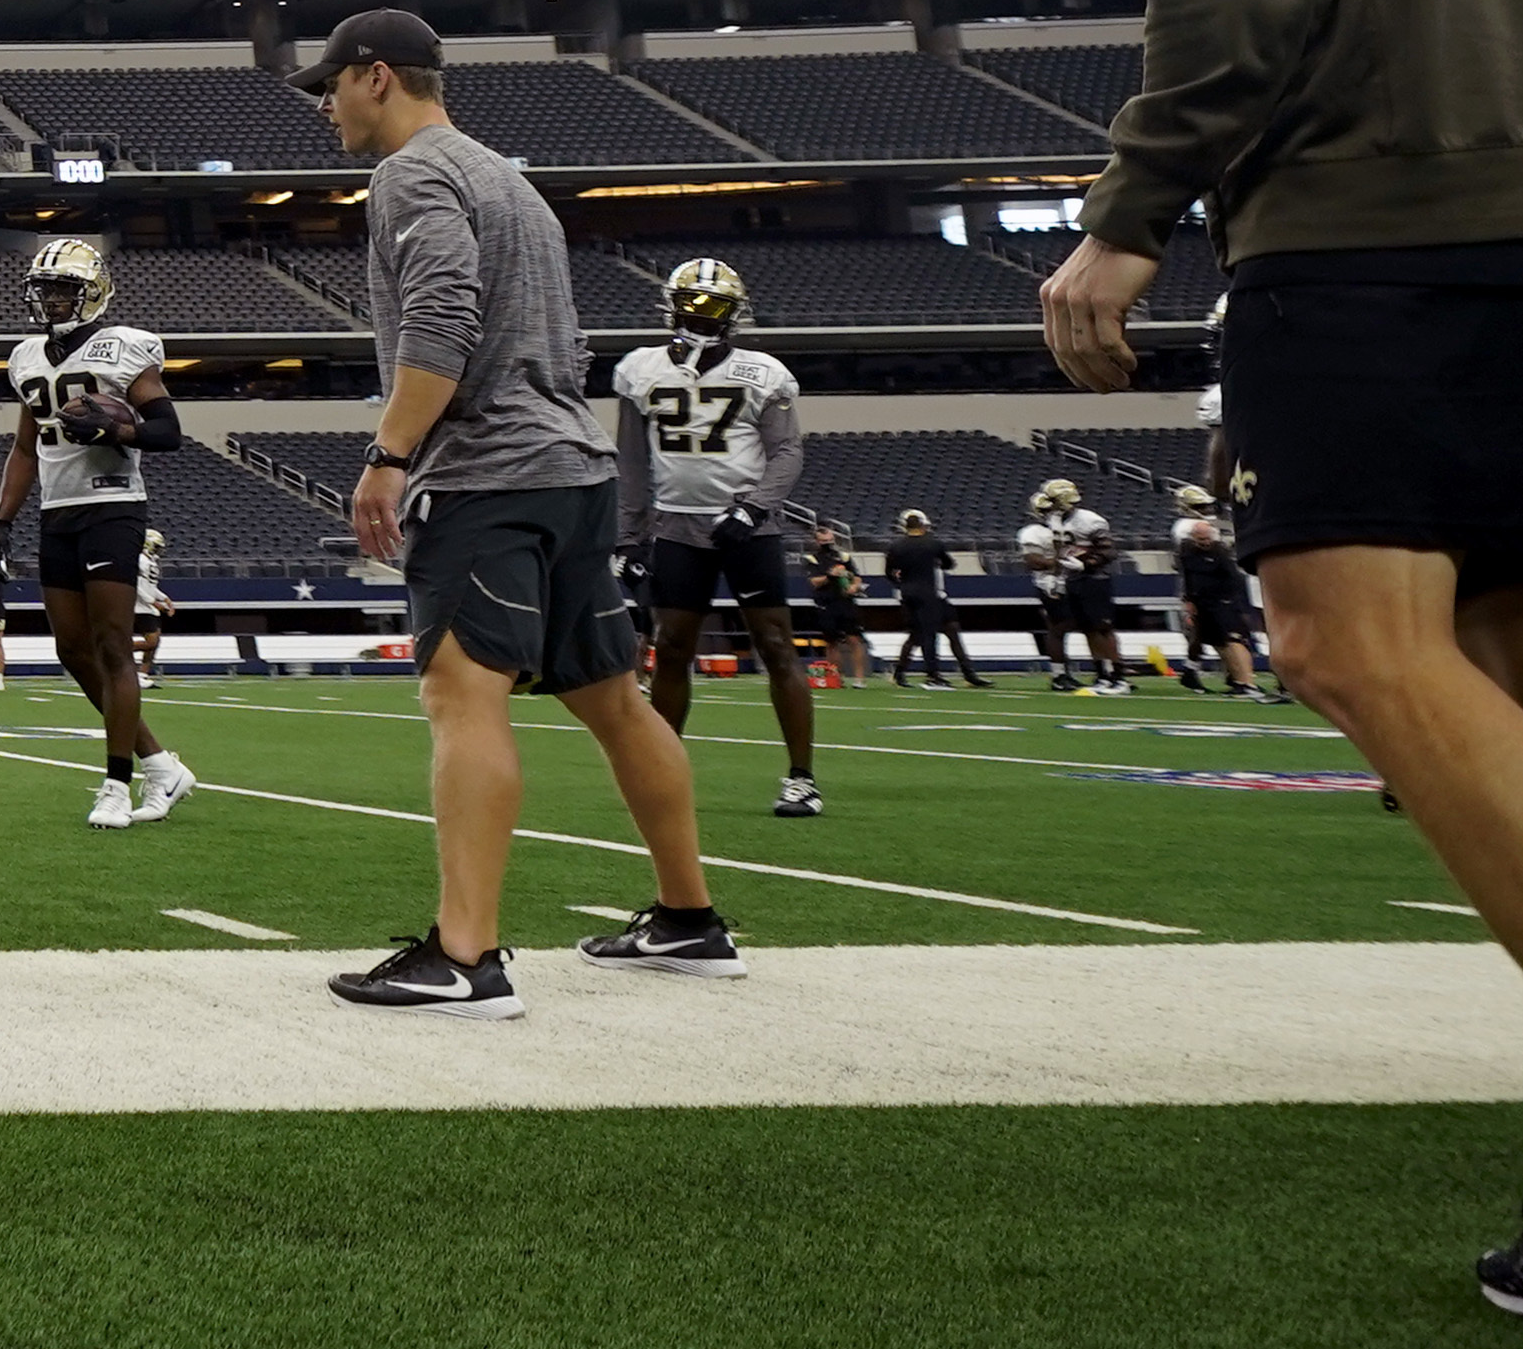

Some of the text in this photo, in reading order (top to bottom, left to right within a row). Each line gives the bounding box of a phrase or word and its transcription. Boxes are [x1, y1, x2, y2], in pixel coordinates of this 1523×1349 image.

[59, 160, 104, 183] 10:00
[92, 341, 114, 350] SEAT
[88, 350, 114, 360] GEEK
[650, 386, 747, 453] 27
